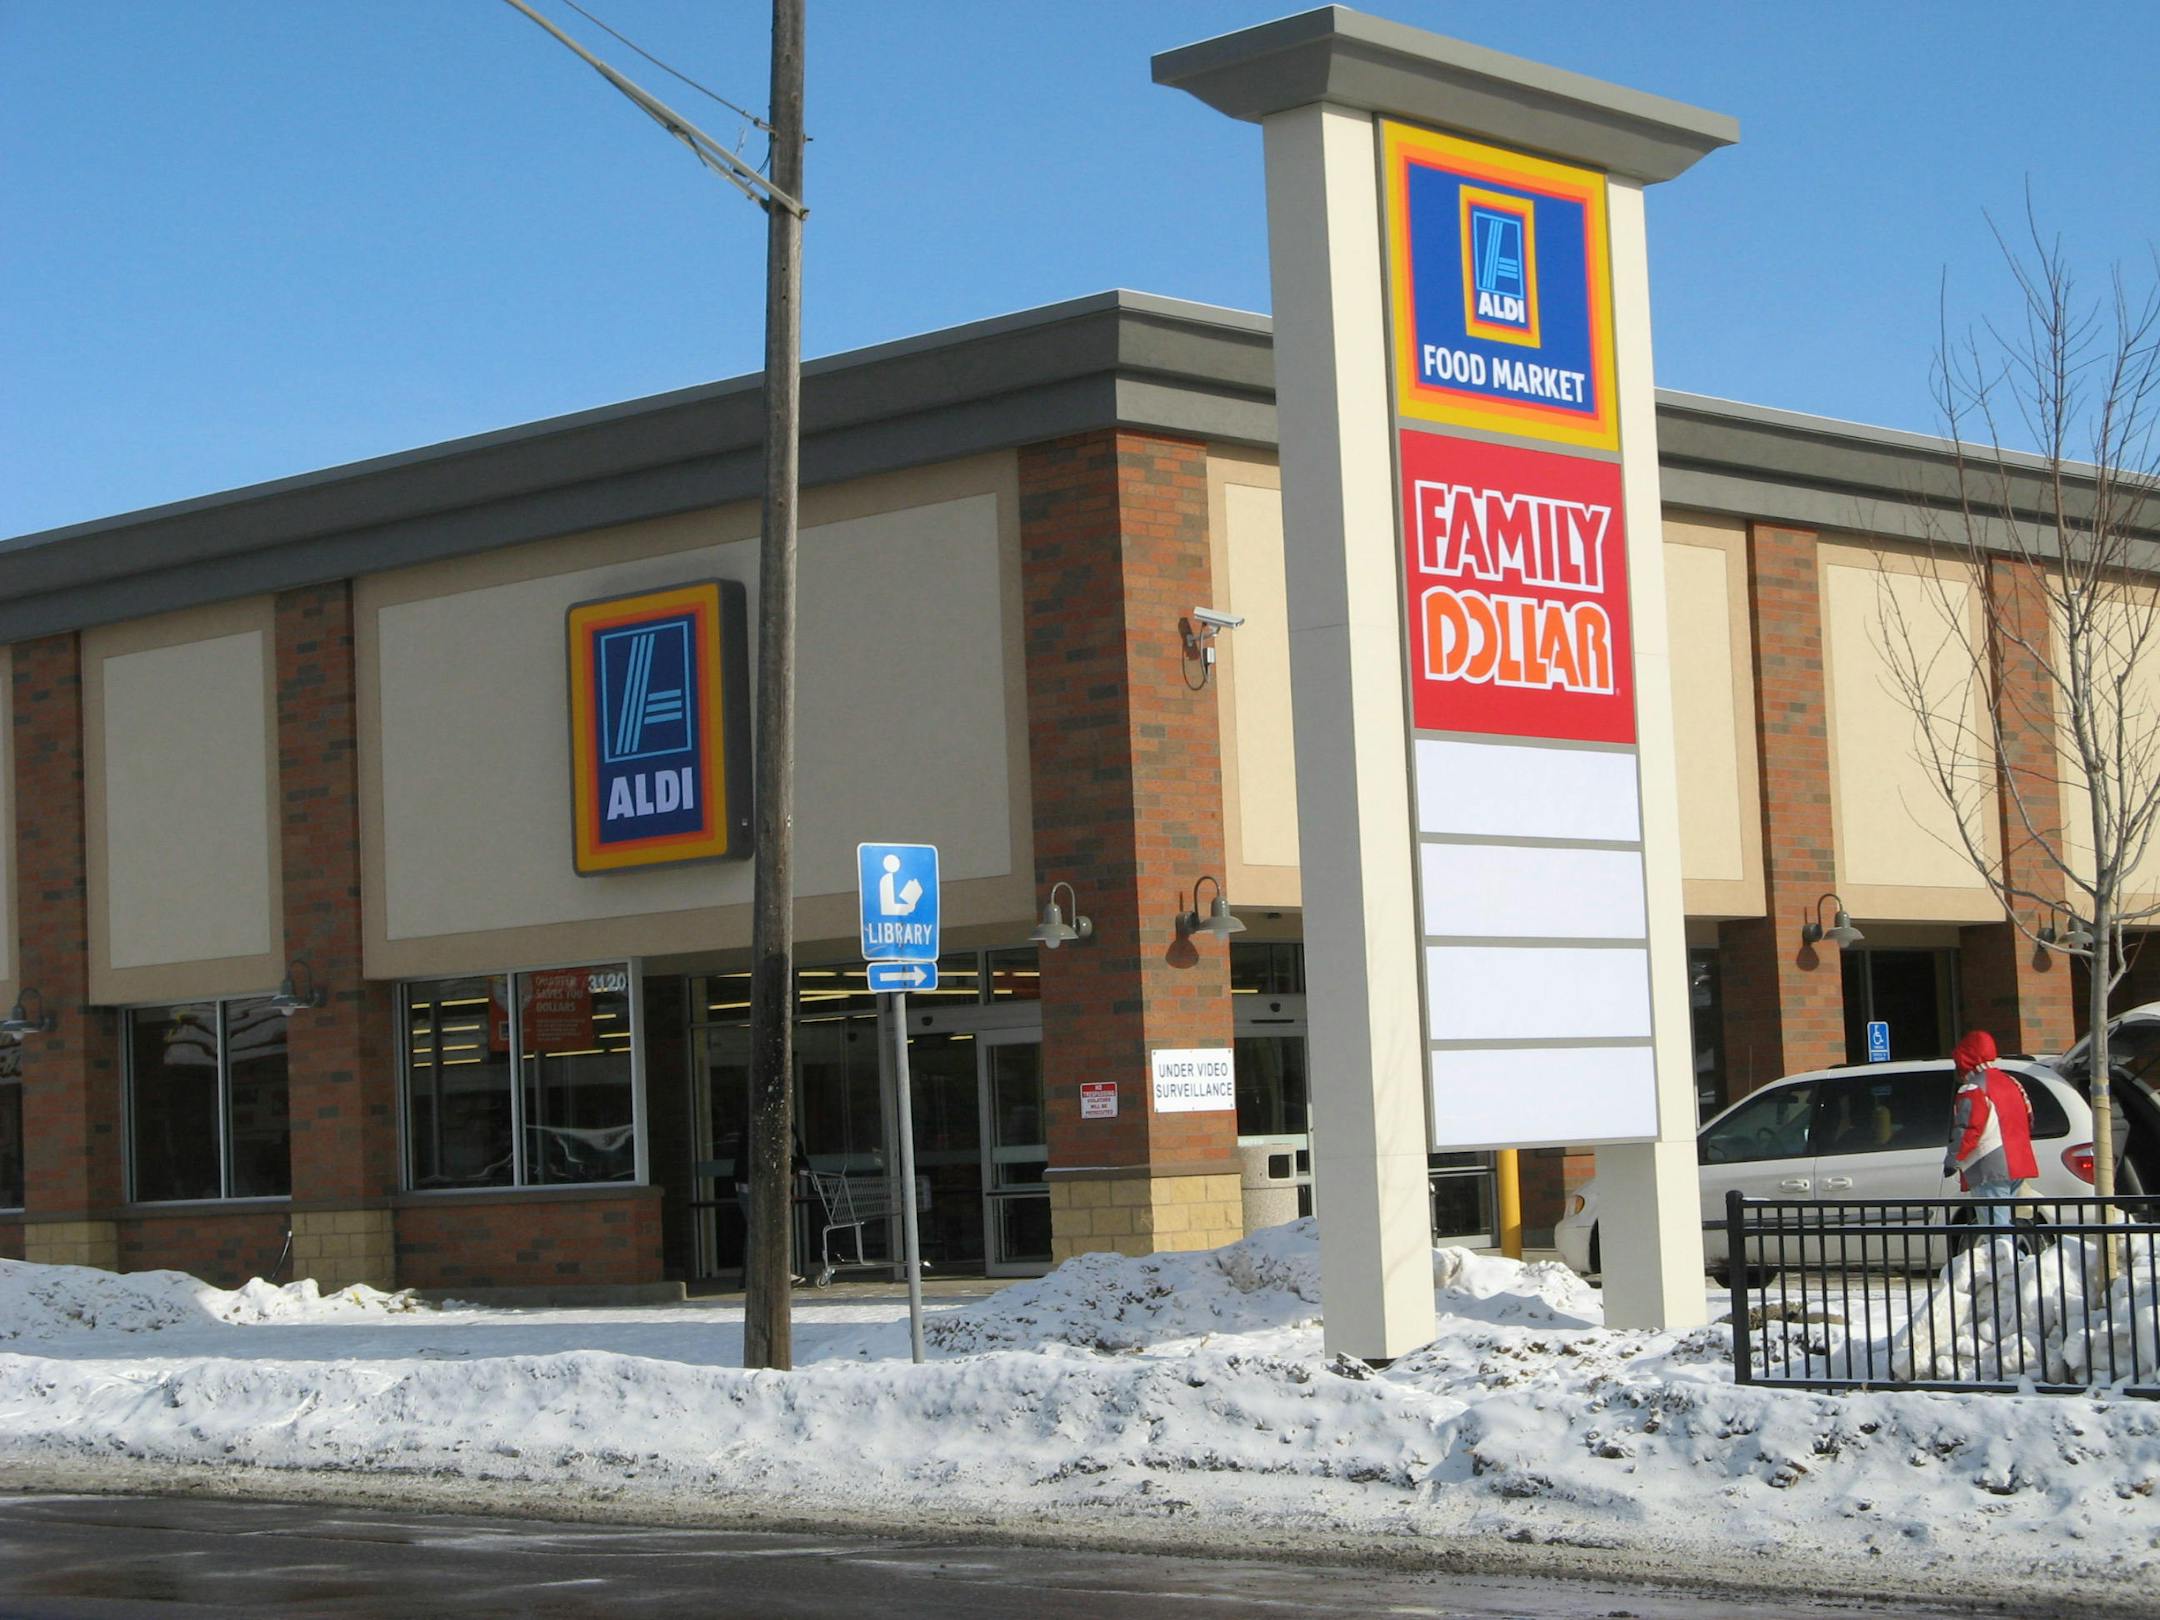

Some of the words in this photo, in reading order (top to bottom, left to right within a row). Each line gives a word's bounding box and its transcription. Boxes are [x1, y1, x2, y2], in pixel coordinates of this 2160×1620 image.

[1478, 291, 1526, 323] ALDI
[1423, 344, 1486, 385] FOOD
[1492, 357, 1585, 403] MARKET
[1414, 479, 1612, 594] FAMILY
[1420, 585, 1614, 696] DOLLAR
[606, 766, 694, 821] ALDI
[868, 922, 933, 946] LIBRARY
[587, 972, 627, 993] 3120
[1158, 1063, 1194, 1078] UNDER
[1197, 1062, 1228, 1077] VIDEO
[1155, 1082, 1233, 1098] SURVEILLANCE
